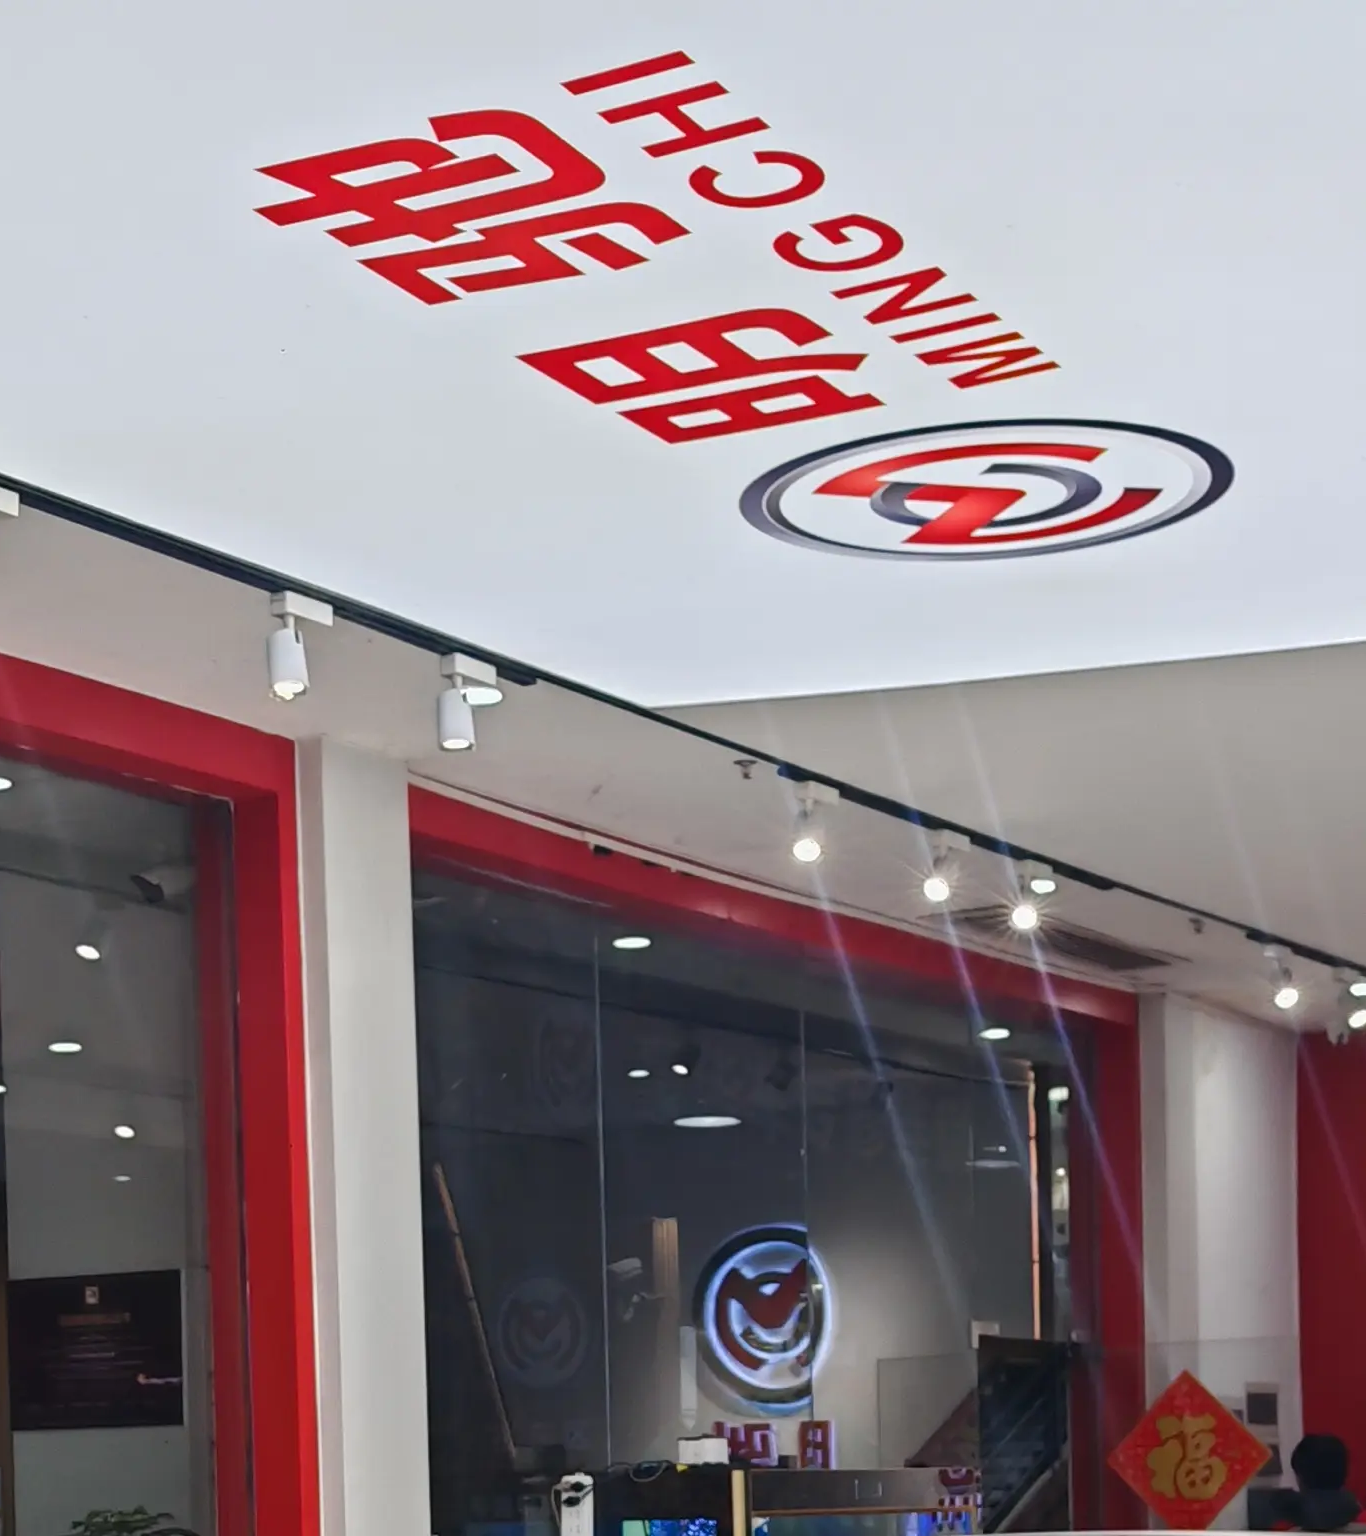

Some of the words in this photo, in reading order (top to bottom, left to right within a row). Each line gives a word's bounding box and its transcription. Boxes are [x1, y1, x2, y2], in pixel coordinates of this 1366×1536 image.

[559, 50, 826, 210] CHI
[253, 108, 886, 445] 明驰
[771, 213, 1062, 390] MING
[1146, 1413, 1228, 1501] 福
